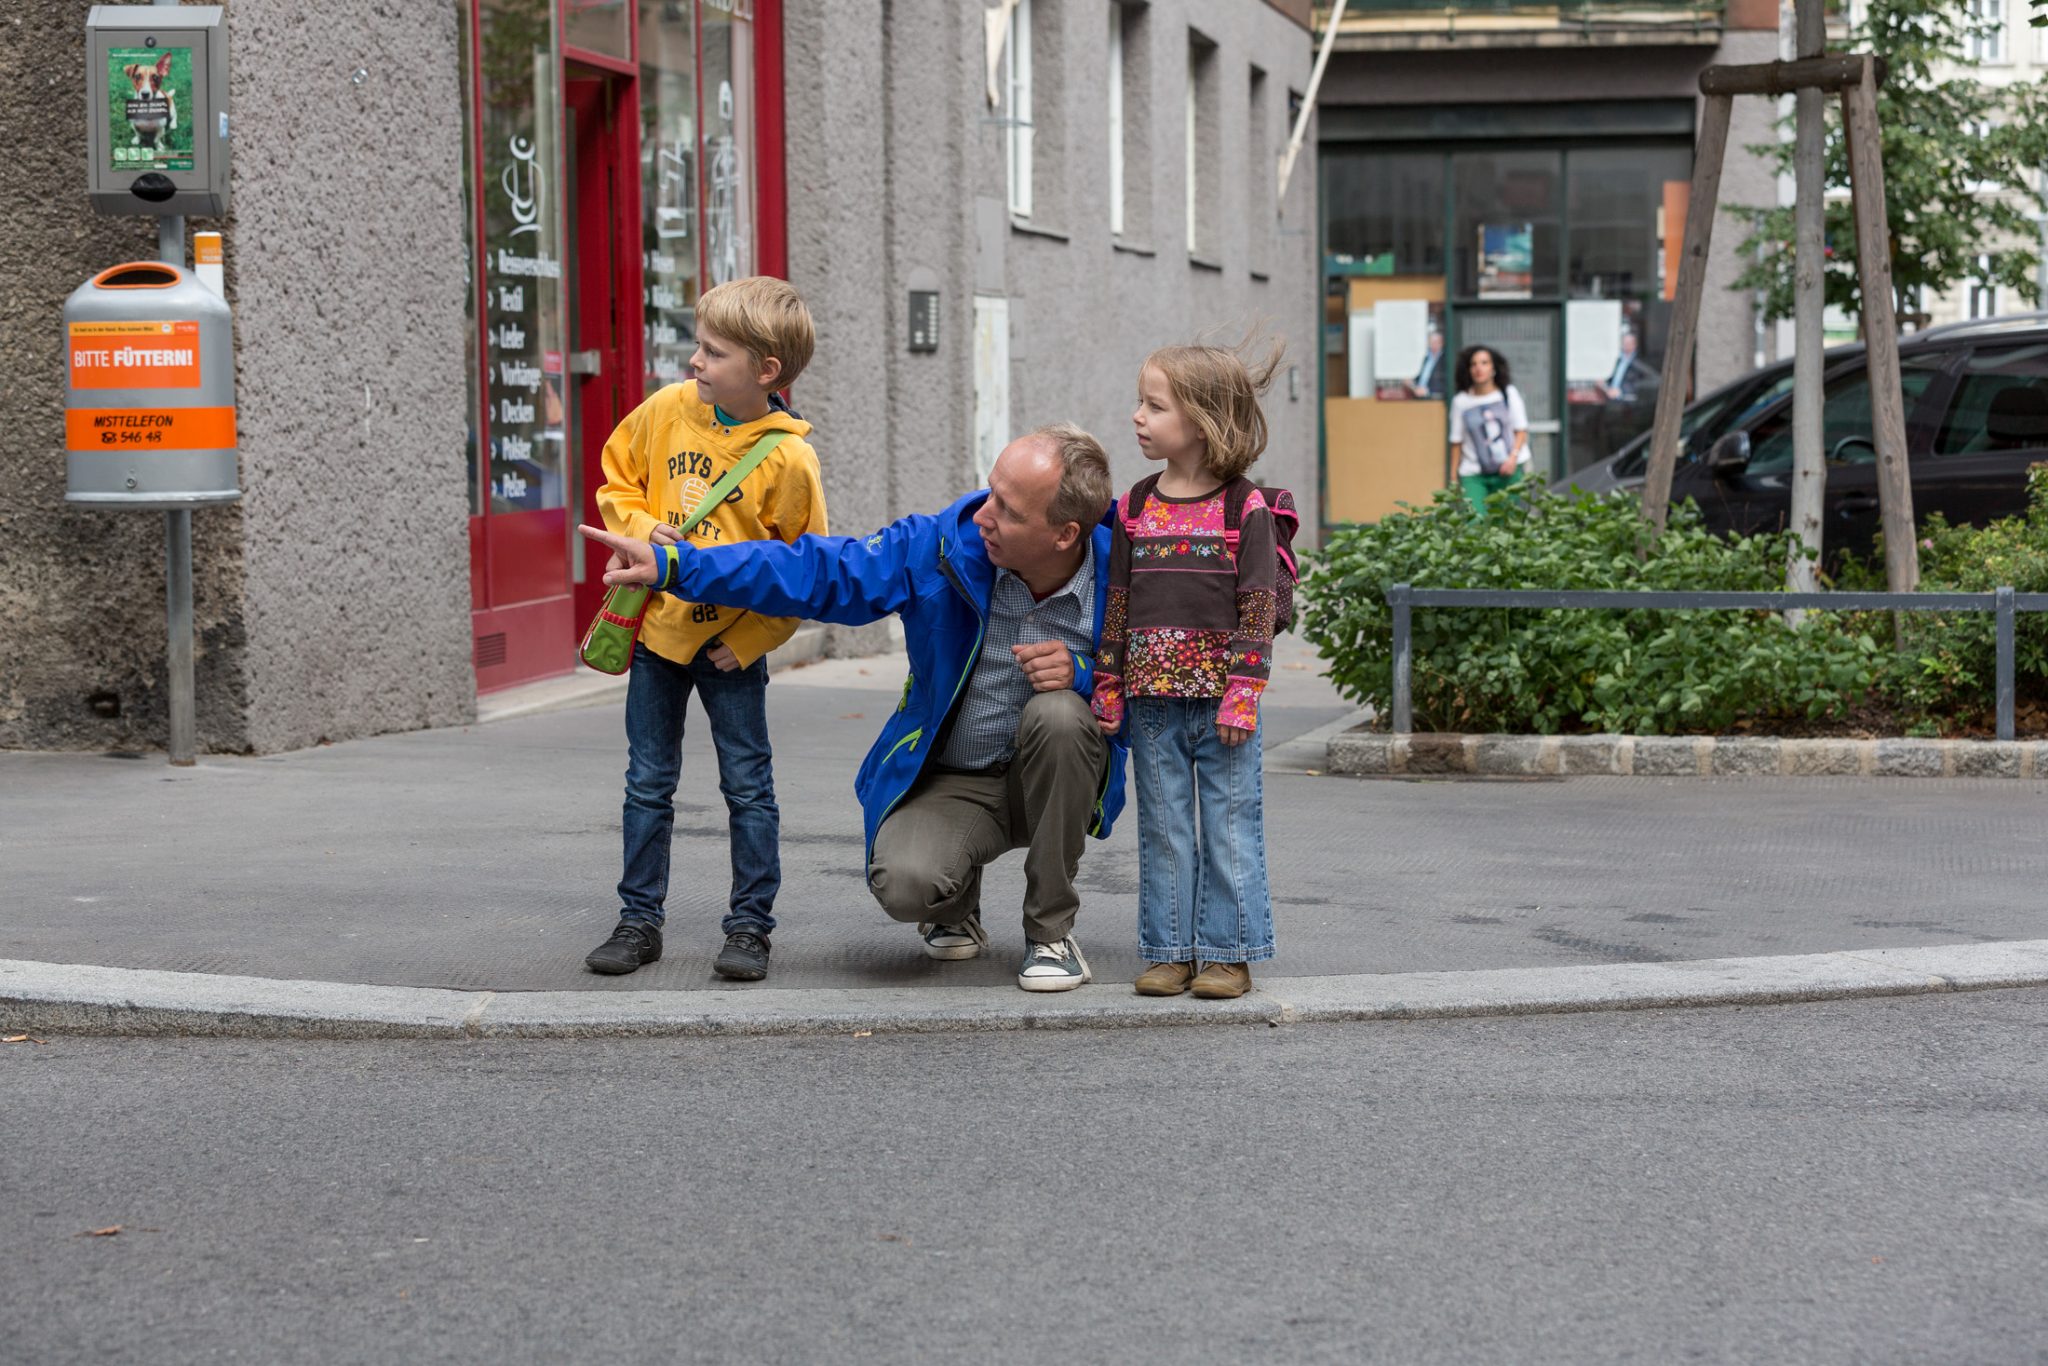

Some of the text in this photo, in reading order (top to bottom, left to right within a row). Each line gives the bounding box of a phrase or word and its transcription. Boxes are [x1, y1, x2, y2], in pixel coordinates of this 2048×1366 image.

[499, 286, 523, 311] Textil
[499, 322, 525, 348] Leder
[74, 346, 193, 367] BITTE FÜTTERN!
[500, 360, 541, 394] Vorhänge
[94, 415, 173, 427] MISTTELEFON
[501, 397, 535, 423] Decken
[121, 431, 162, 443] 546 48
[501, 434, 532, 461] Polster
[668, 451, 713, 480] PHYS
[502, 471, 527, 498] Pelze
